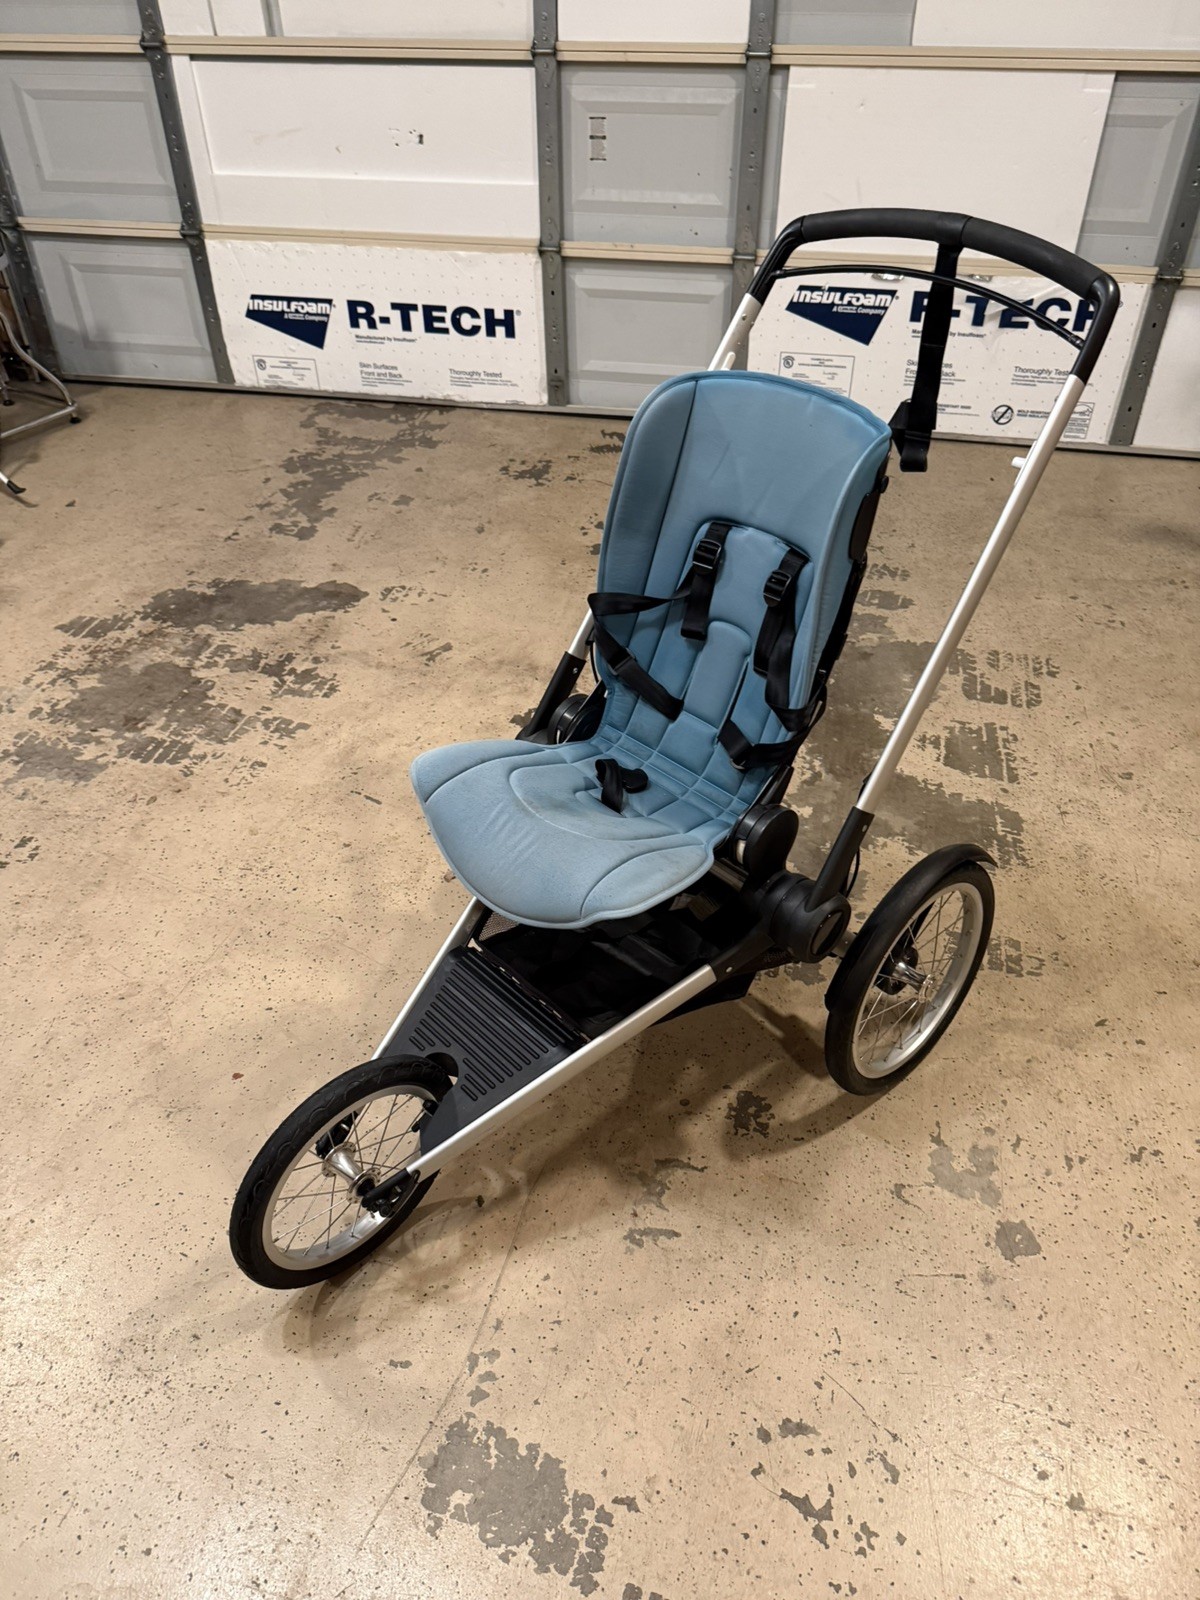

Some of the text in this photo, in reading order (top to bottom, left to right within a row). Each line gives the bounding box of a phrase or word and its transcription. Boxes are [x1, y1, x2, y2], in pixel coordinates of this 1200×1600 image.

[857, 307, 885, 315] Company
[449, 368, 481, 377] Thoroughly
[1014, 366, 1069, 376] Thoroughly Test
